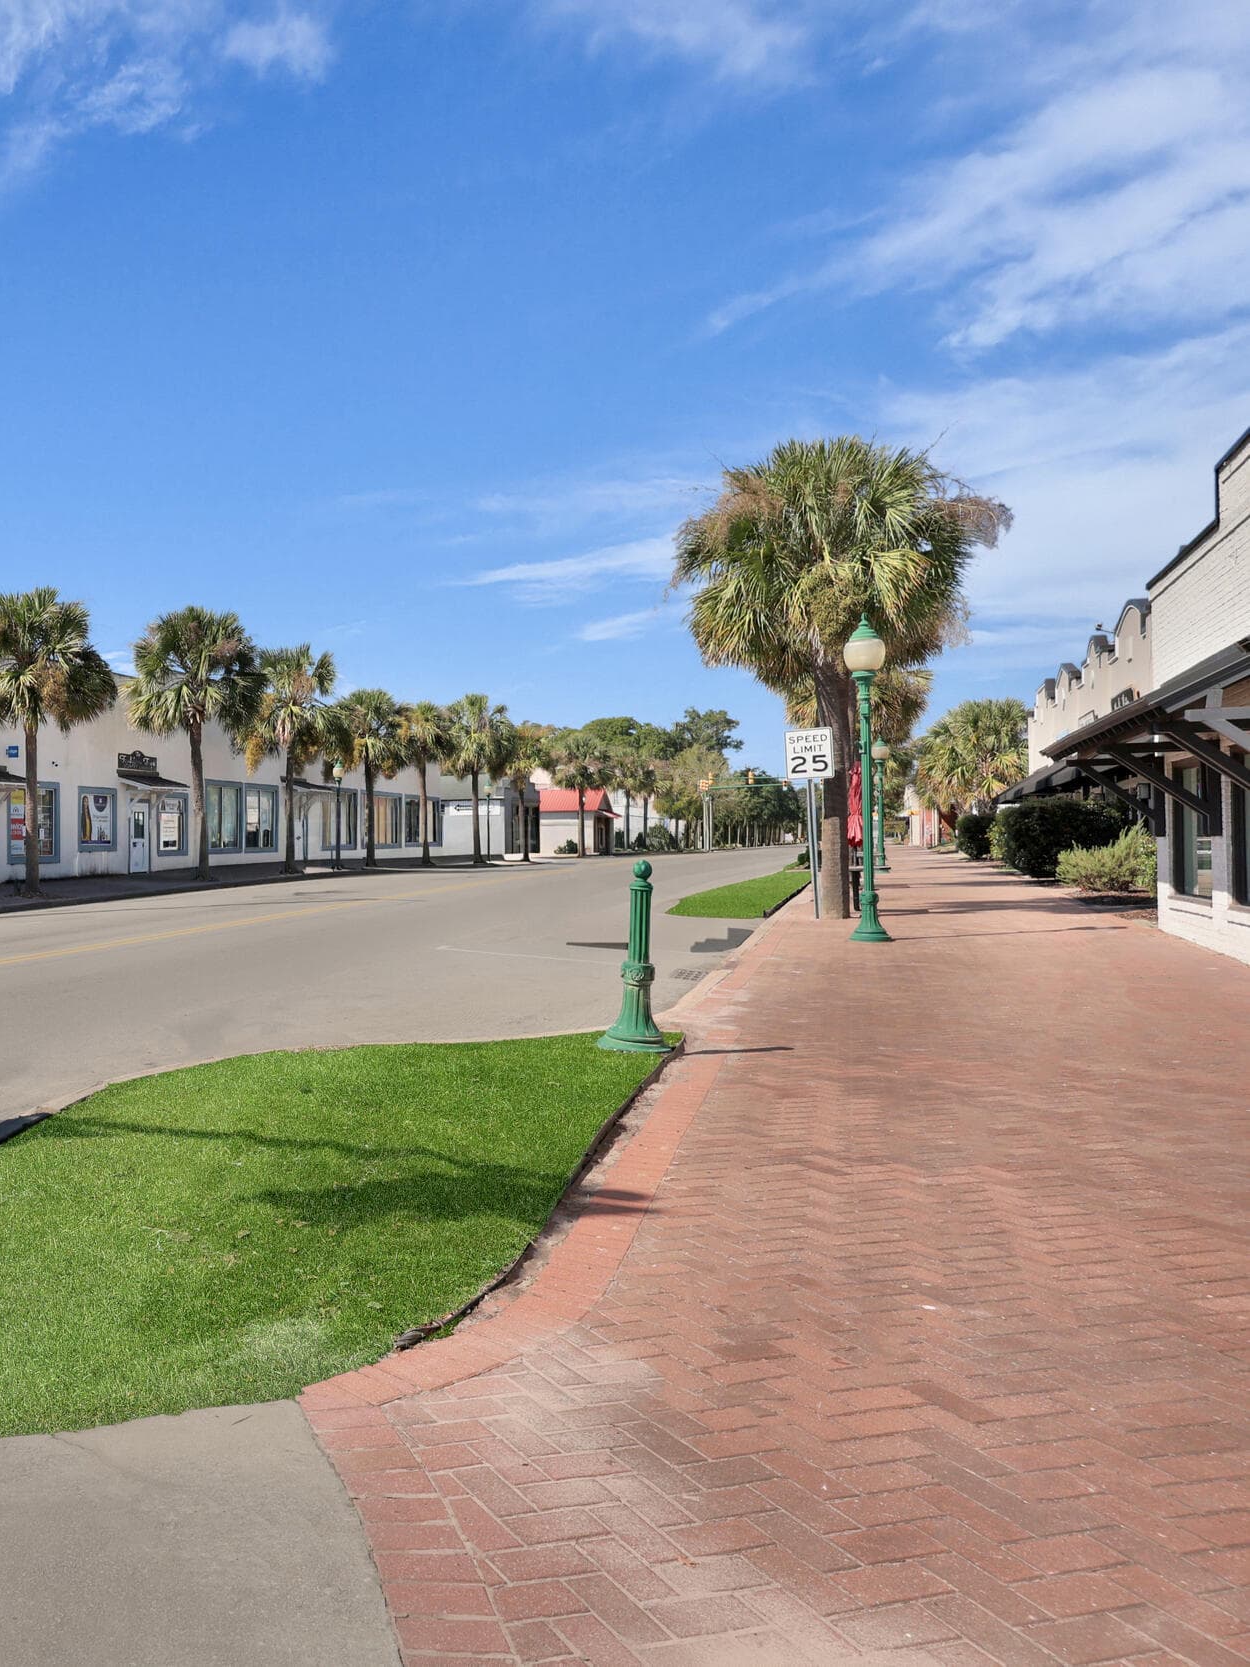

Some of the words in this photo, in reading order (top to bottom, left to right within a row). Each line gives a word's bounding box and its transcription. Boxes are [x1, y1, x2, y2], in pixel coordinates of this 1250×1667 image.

[788, 734, 828, 745] SPEED
[793, 744, 823, 754] LIMIT
[791, 754, 828, 774] 25
